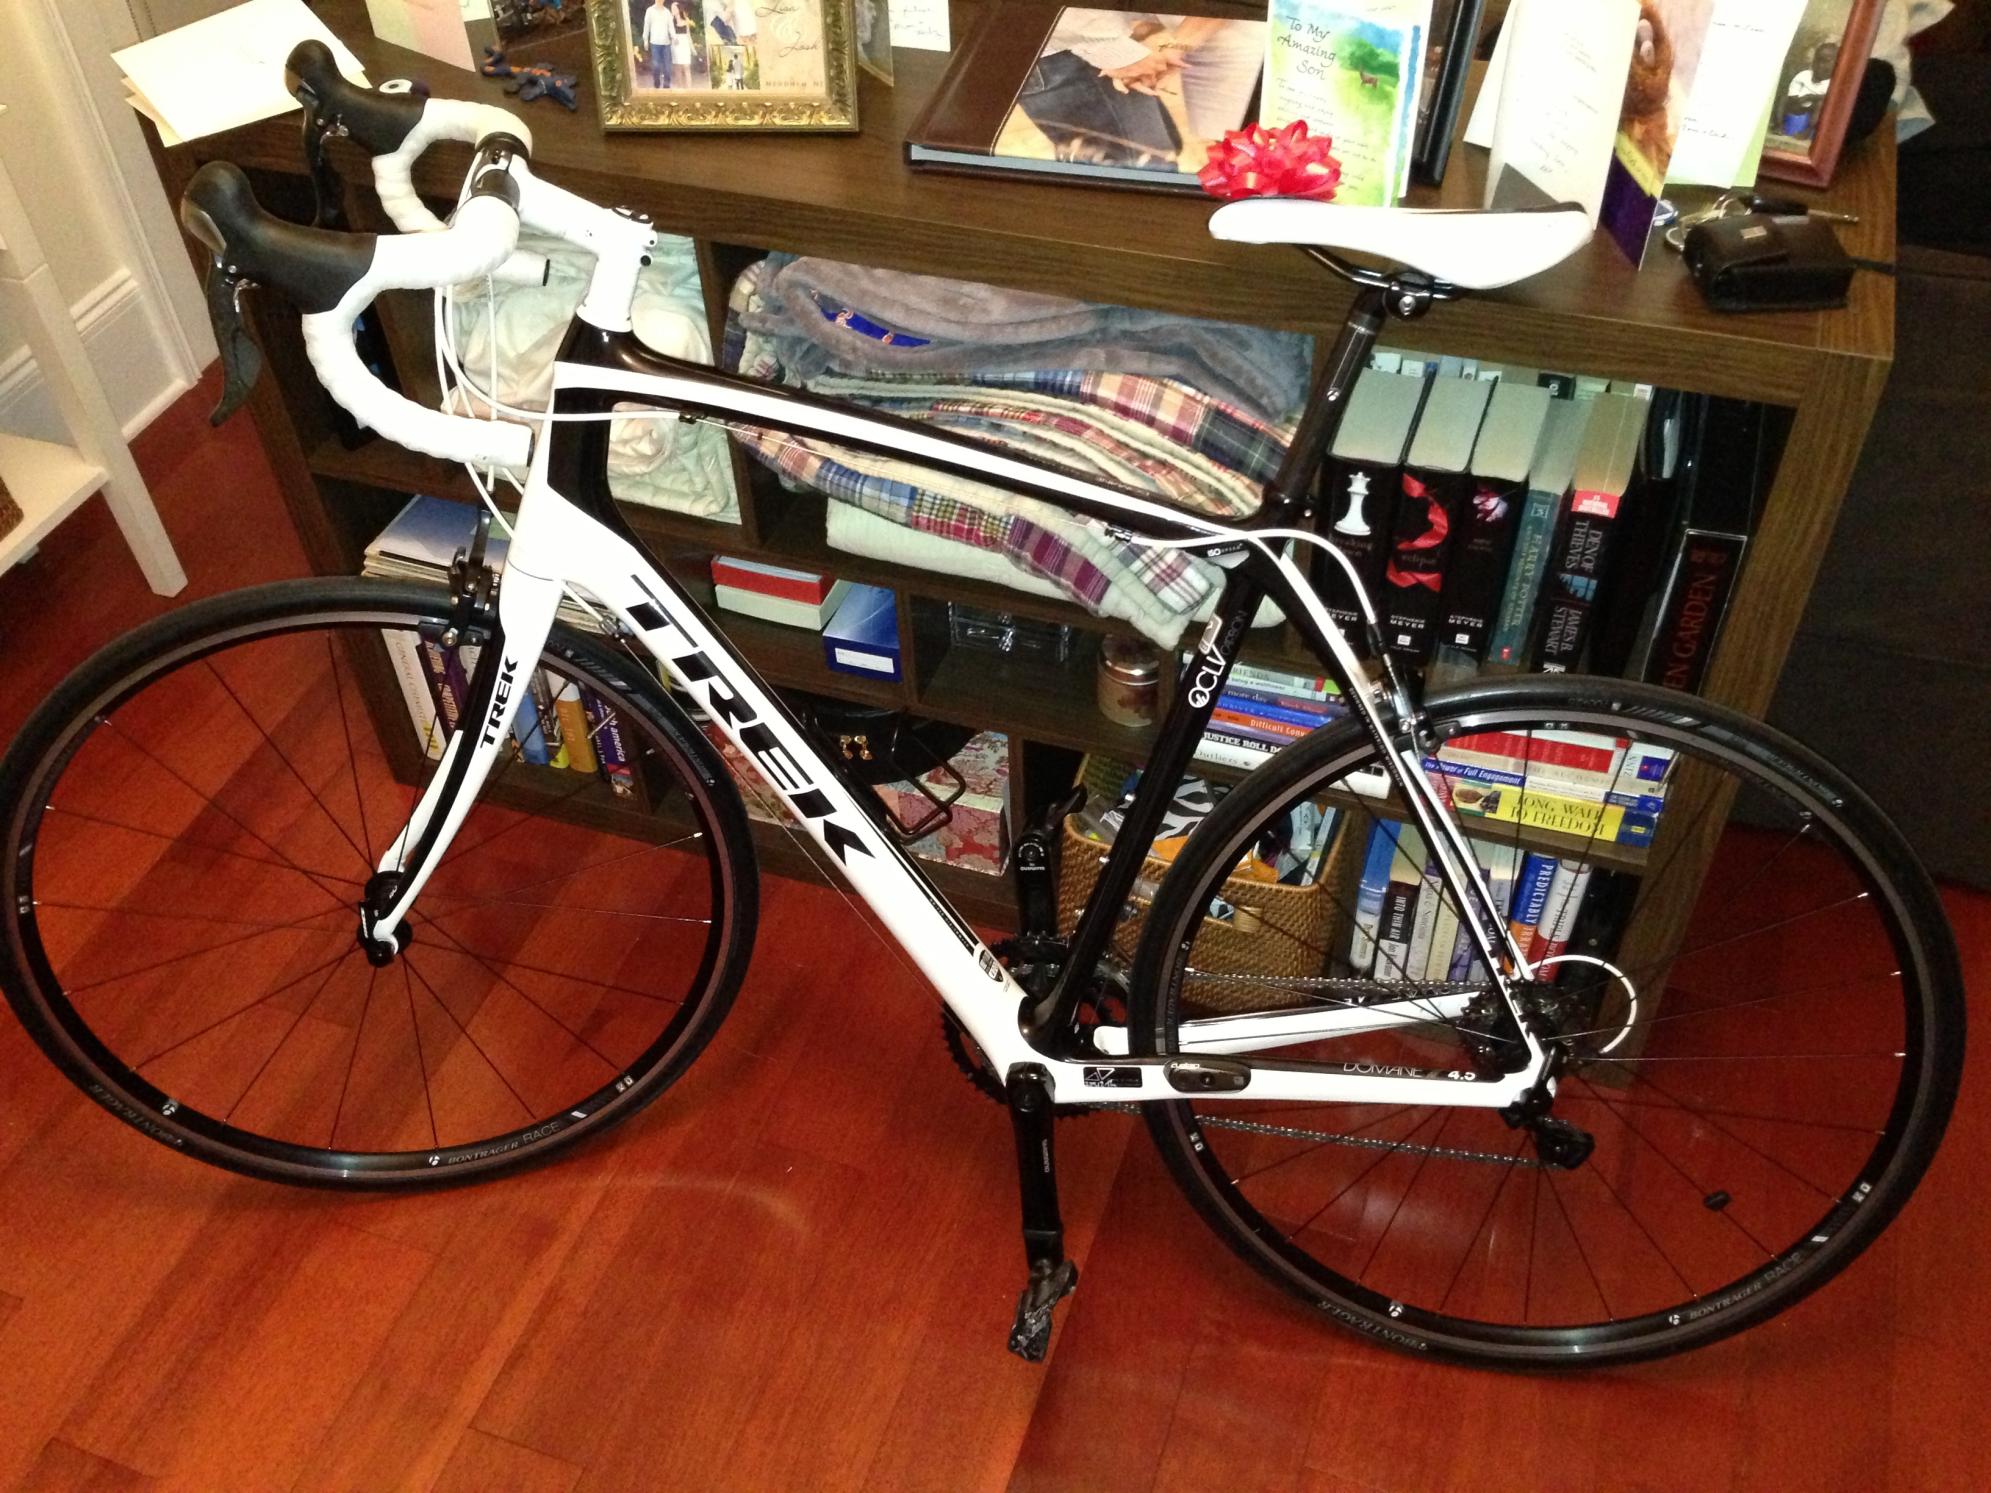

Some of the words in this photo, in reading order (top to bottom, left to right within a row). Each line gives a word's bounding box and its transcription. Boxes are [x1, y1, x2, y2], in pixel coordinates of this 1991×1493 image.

[1286, 15, 1303, 32] To
[1307, 23, 1331, 43] My
[1277, 34, 1337, 68] Amazing
[1296, 59, 1325, 81] Son
[1524, 533, 1543, 577] HARRY
[1565, 520, 1591, 570] THIEVES
[1585, 529, 1604, 558] DEN
[1511, 582, 1531, 627] POTTER
[1672, 575, 1717, 659] GARDEN
[1219, 610, 1249, 657] CARBON
[1390, 619, 1425, 629] MEYER
[1448, 619, 1483, 628] MEYER
[1545, 606, 1566, 656] STEWART
[1563, 607, 1583, 640] JAMES
[479, 655, 519, 749] TREK
[1227, 690, 1251, 700] more
[624, 574, 876, 866] TREK
[1249, 719, 1284, 734] Difficult
[611, 726, 627, 762] america
[1203, 732, 1241, 747] JUSTICE
[1242, 739, 1269, 752] ROLL
[1464, 765, 1478, 778] Full
[1478, 769, 1522, 787] Engagement
[1510, 805, 1529, 822] TO
[1393, 895, 1407, 912] INTO
[1526, 864, 1555, 925] PREDICTABLY
[1389, 928, 1401, 940] AIR
[1390, 911, 1405, 928] THIN
[1554, 908, 1569, 940] TRIPLE
[1343, 1061, 1424, 1079] DOMANE
[447, 1141, 520, 1165] BONTRAGER
[522, 1121, 561, 1146] RACE
[1689, 1281, 1762, 1320] BONTRAGER
[1763, 1252, 1801, 1282] RACE
[1317, 1300, 1419, 1349] BONTRAGER
